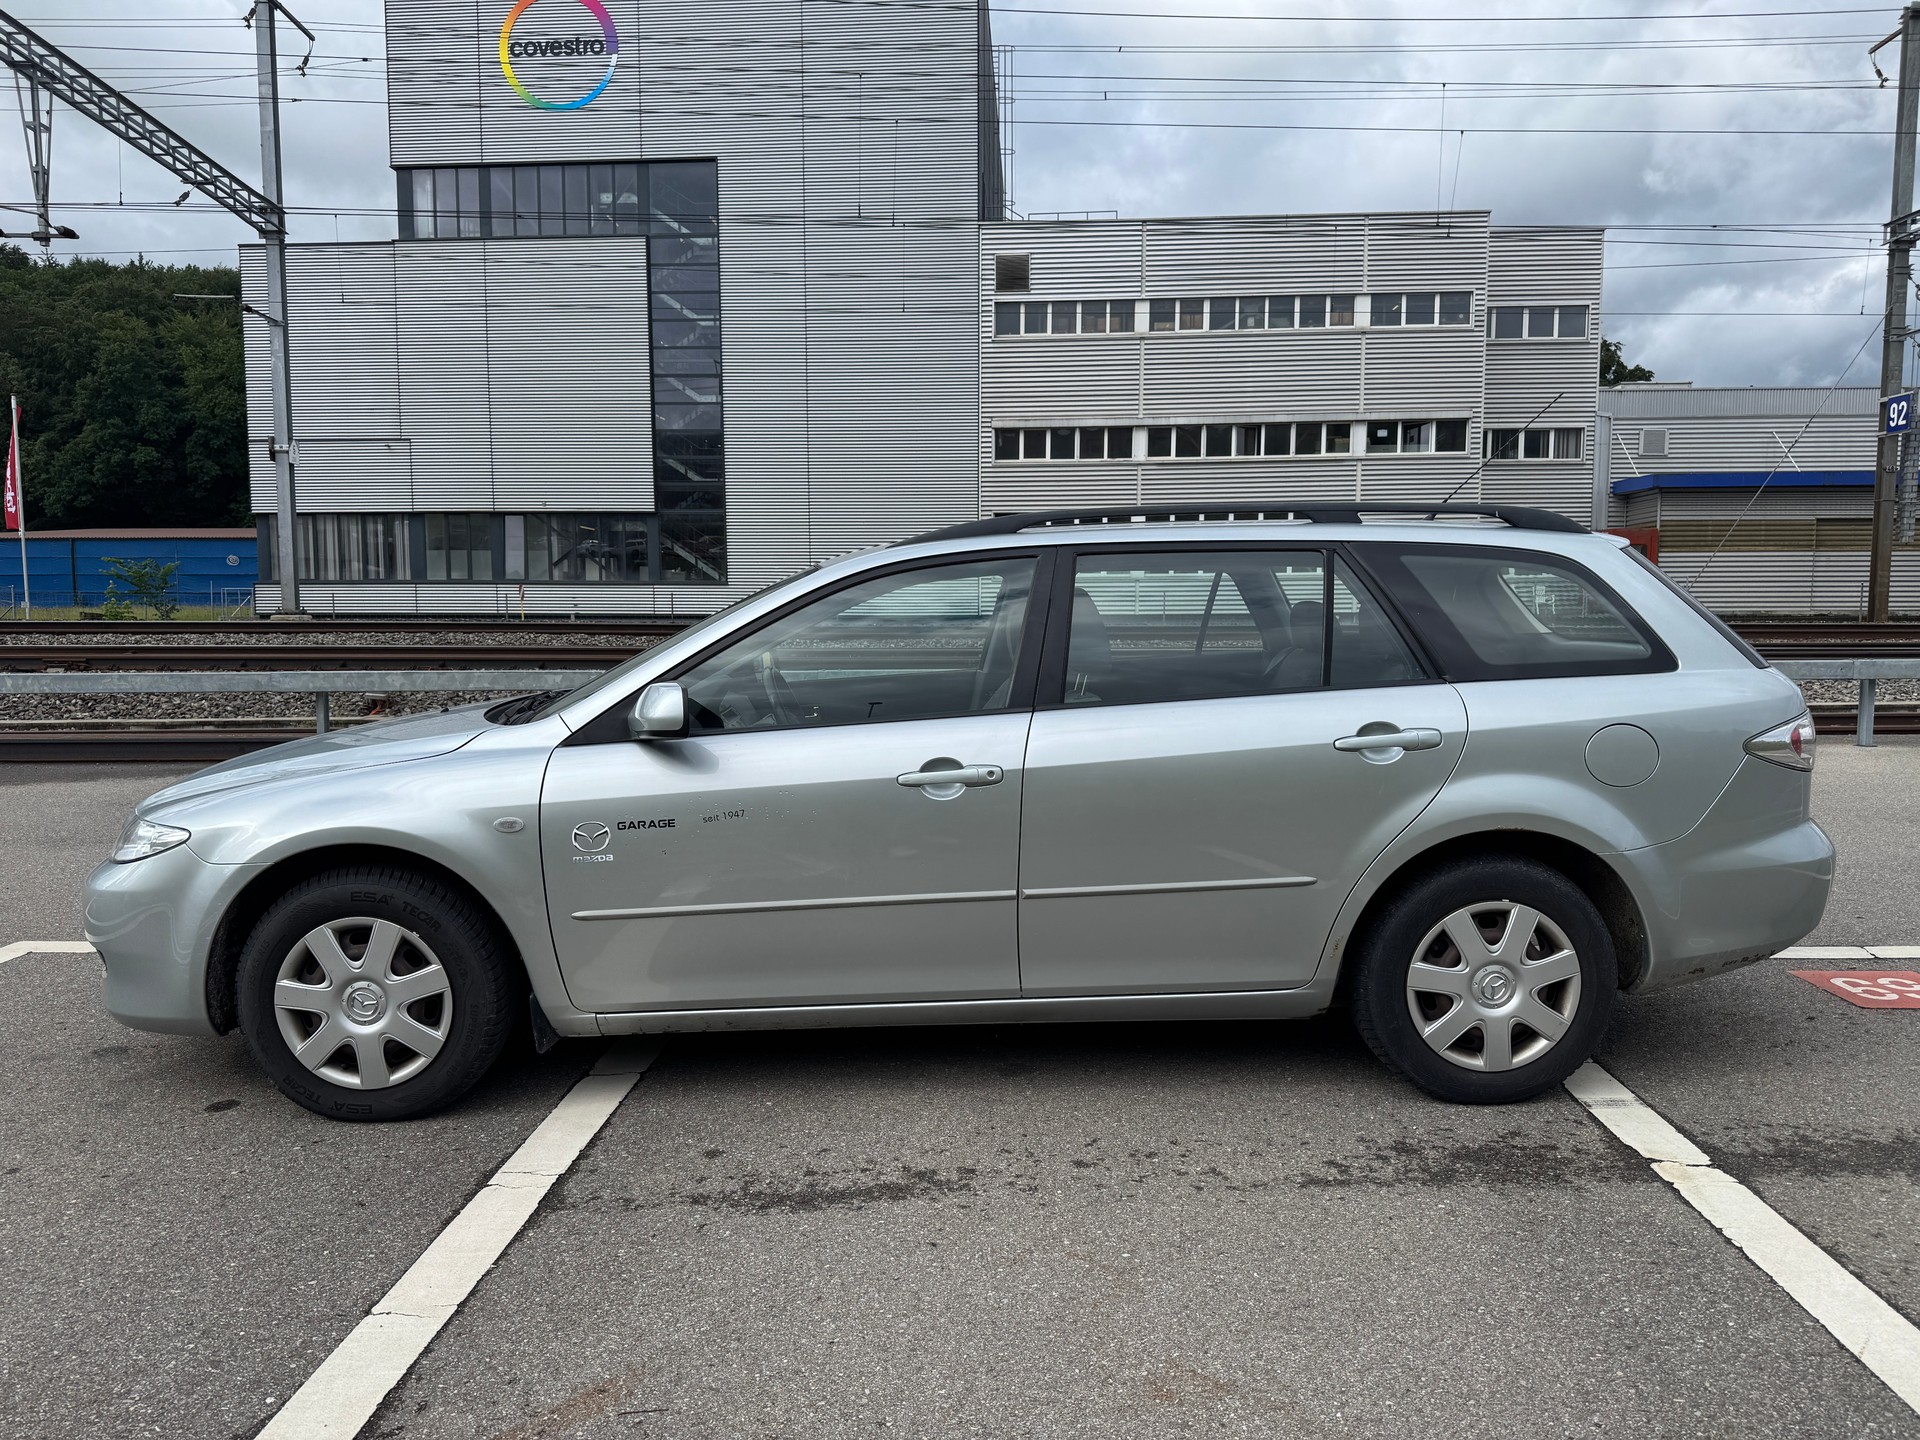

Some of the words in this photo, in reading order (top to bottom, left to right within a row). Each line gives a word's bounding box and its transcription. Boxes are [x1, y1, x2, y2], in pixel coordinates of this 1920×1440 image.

[509, 36, 605, 57] covestro
[1889, 401, 1907, 427] 92
[616, 818, 676, 831] GARAGE
[702, 814, 720, 824] seit
[723, 809, 745, 821] 1947
[402, 900, 442, 932] TECAR
